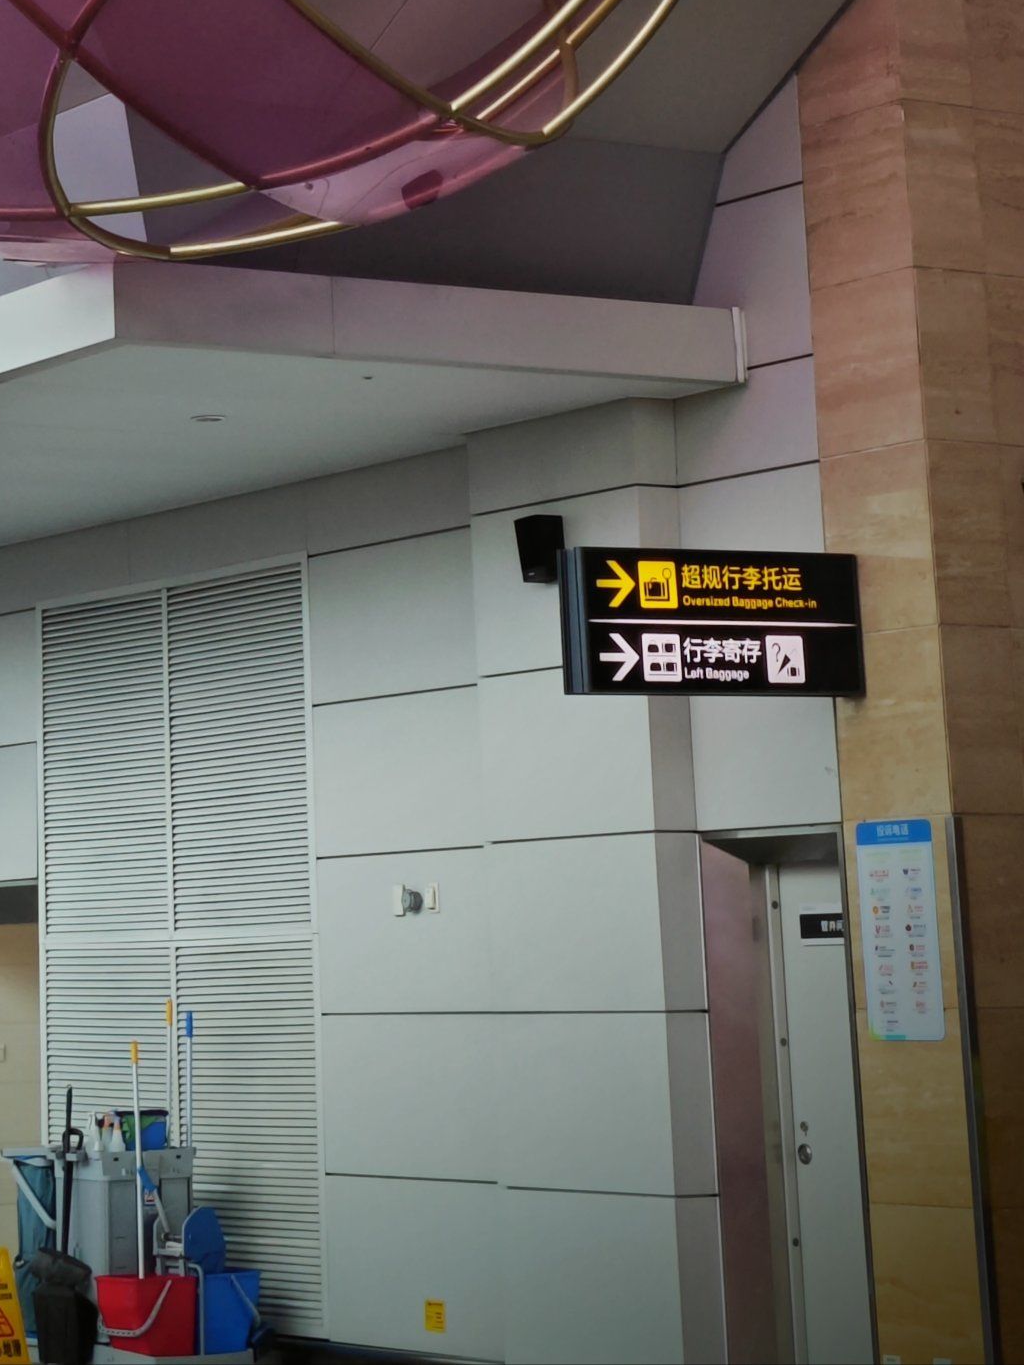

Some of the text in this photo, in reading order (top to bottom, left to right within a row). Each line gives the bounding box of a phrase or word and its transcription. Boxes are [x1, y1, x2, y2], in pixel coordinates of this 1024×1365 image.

[681, 564, 802, 590] 超规行李托运
[682, 595, 817, 610] Oversized Baggage Check-in
[682, 637, 762, 664] 行李寄存
[684, 667, 750, 682] Left Baggage
